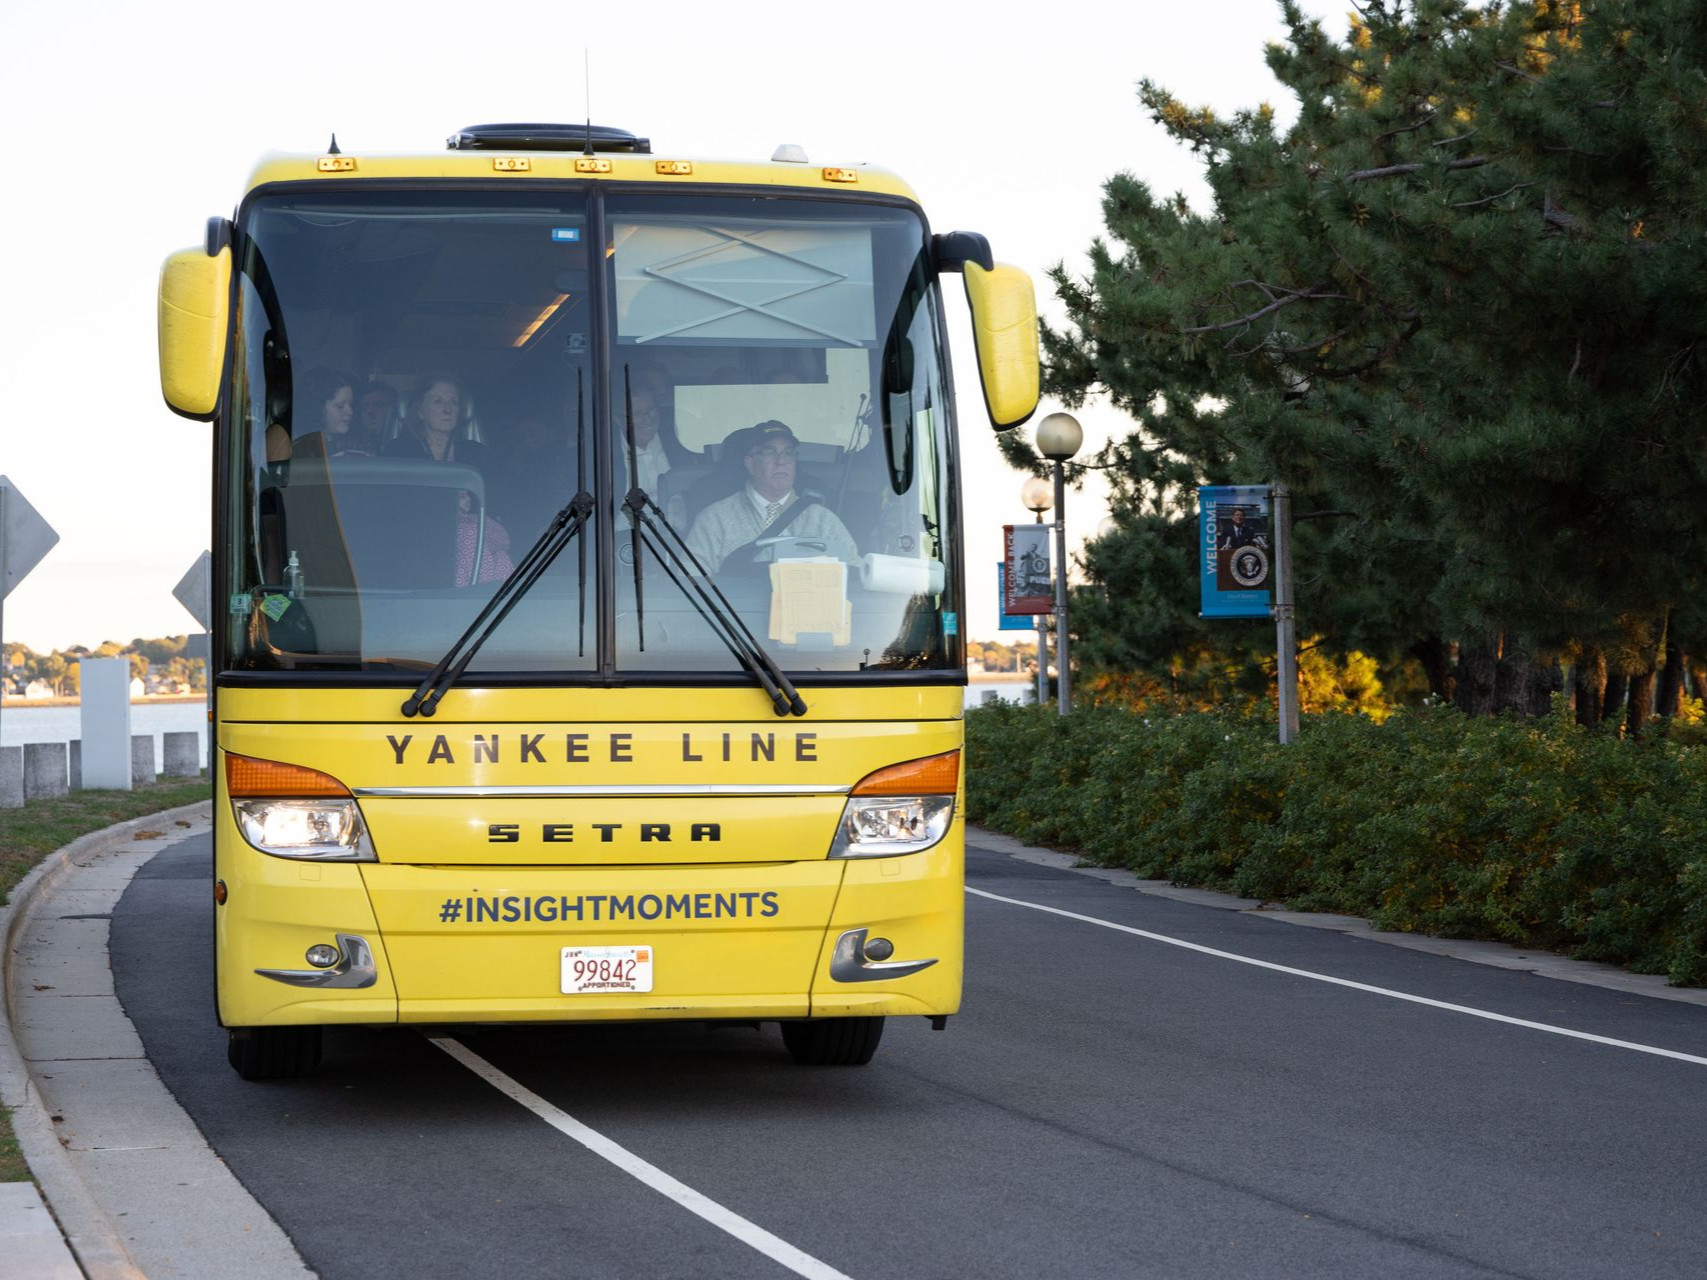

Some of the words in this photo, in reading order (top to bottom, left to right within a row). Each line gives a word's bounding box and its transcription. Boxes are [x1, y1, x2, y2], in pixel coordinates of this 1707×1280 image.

[1007, 533, 1015, 555] BACK
[1206, 500, 1217, 574] WELCOME
[1008, 559, 1016, 607] WELCOME
[387, 734, 633, 764] YANKEE
[682, 733, 818, 762] LINE
[488, 823, 721, 843] SETRA
[440, 892, 779, 923] #INSIGHTMOMENTS
[574, 959, 636, 981] 99842
